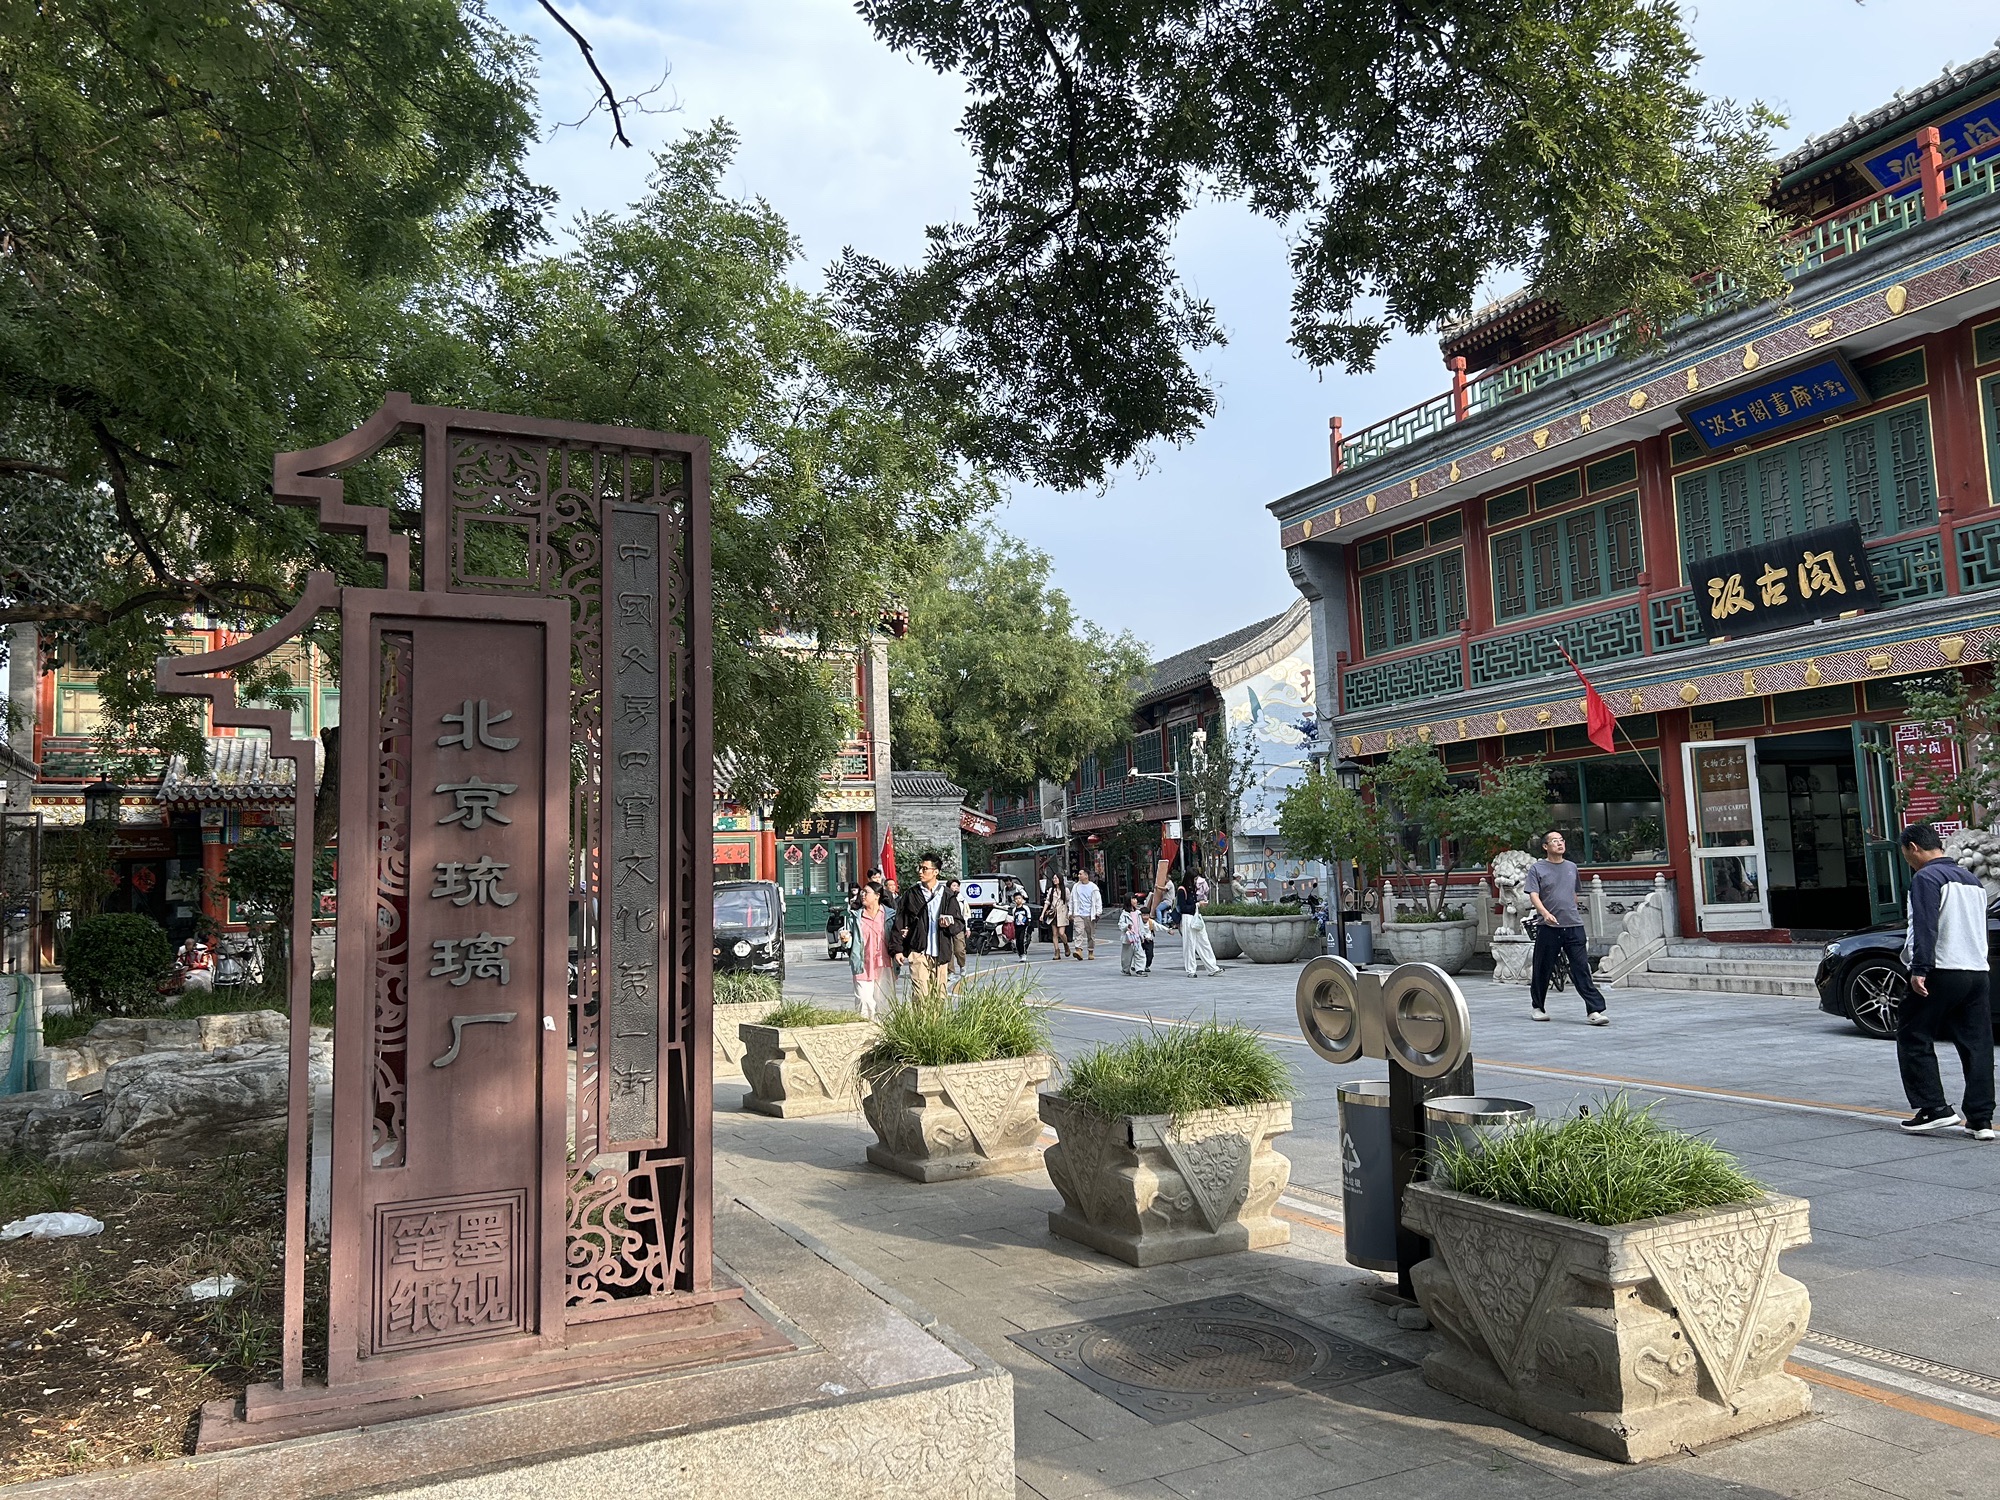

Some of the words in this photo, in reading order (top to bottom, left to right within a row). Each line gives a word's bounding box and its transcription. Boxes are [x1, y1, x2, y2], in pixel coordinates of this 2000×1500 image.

[1706, 385, 1813, 437] 汲古閣畫廊
[1695, 730, 1708, 740] 134
[1703, 755, 1744, 768] 文物艺术品
[1709, 772, 1741, 783] 鉴定中心
[1705, 804, 1727, 812] ANTIQUE
[1728, 803, 1748, 811] CARPET
[431, 698, 520, 1068] 北京琉璃厂
[392, 1210, 509, 1272] 笔墨
[389, 1270, 510, 1333] 纸砚
